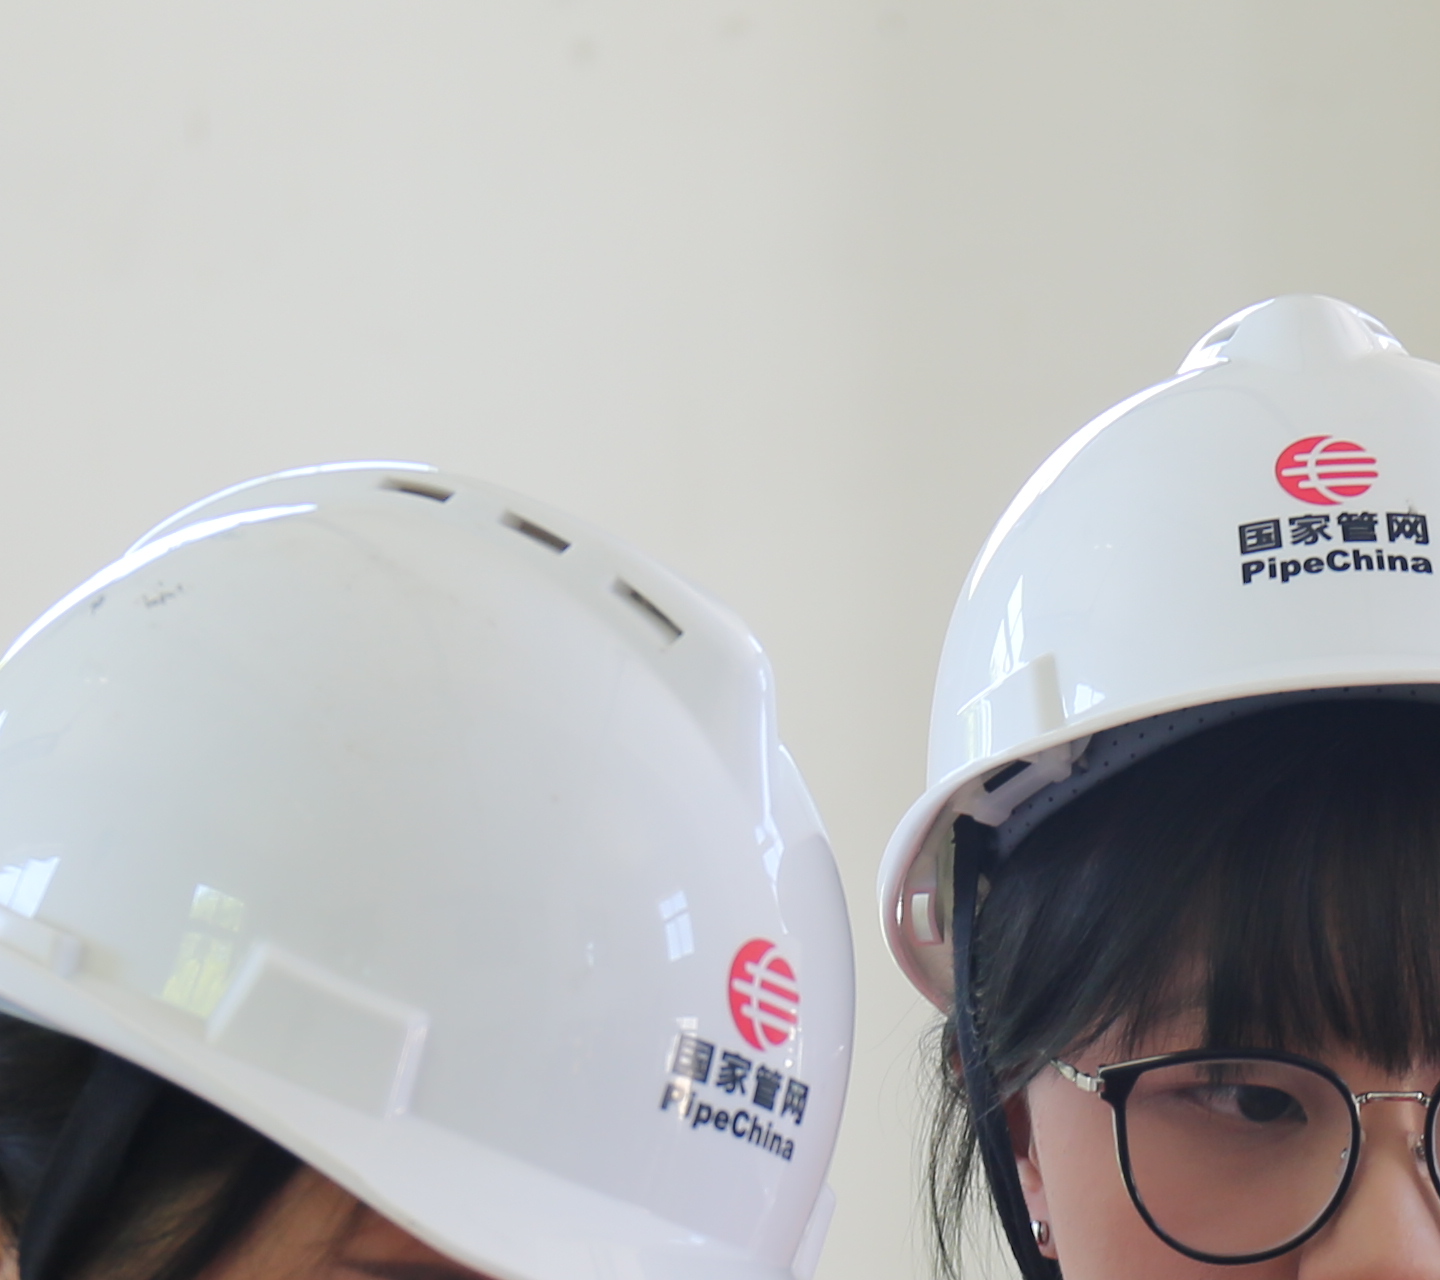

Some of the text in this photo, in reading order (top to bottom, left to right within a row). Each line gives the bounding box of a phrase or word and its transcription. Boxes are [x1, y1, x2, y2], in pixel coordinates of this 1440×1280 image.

[1238, 511, 1430, 554] 国家管网
[1241, 549, 1433, 585] PipeChina
[672, 1032, 810, 1126] 国家管网
[659, 1082, 795, 1161] PipeChina
